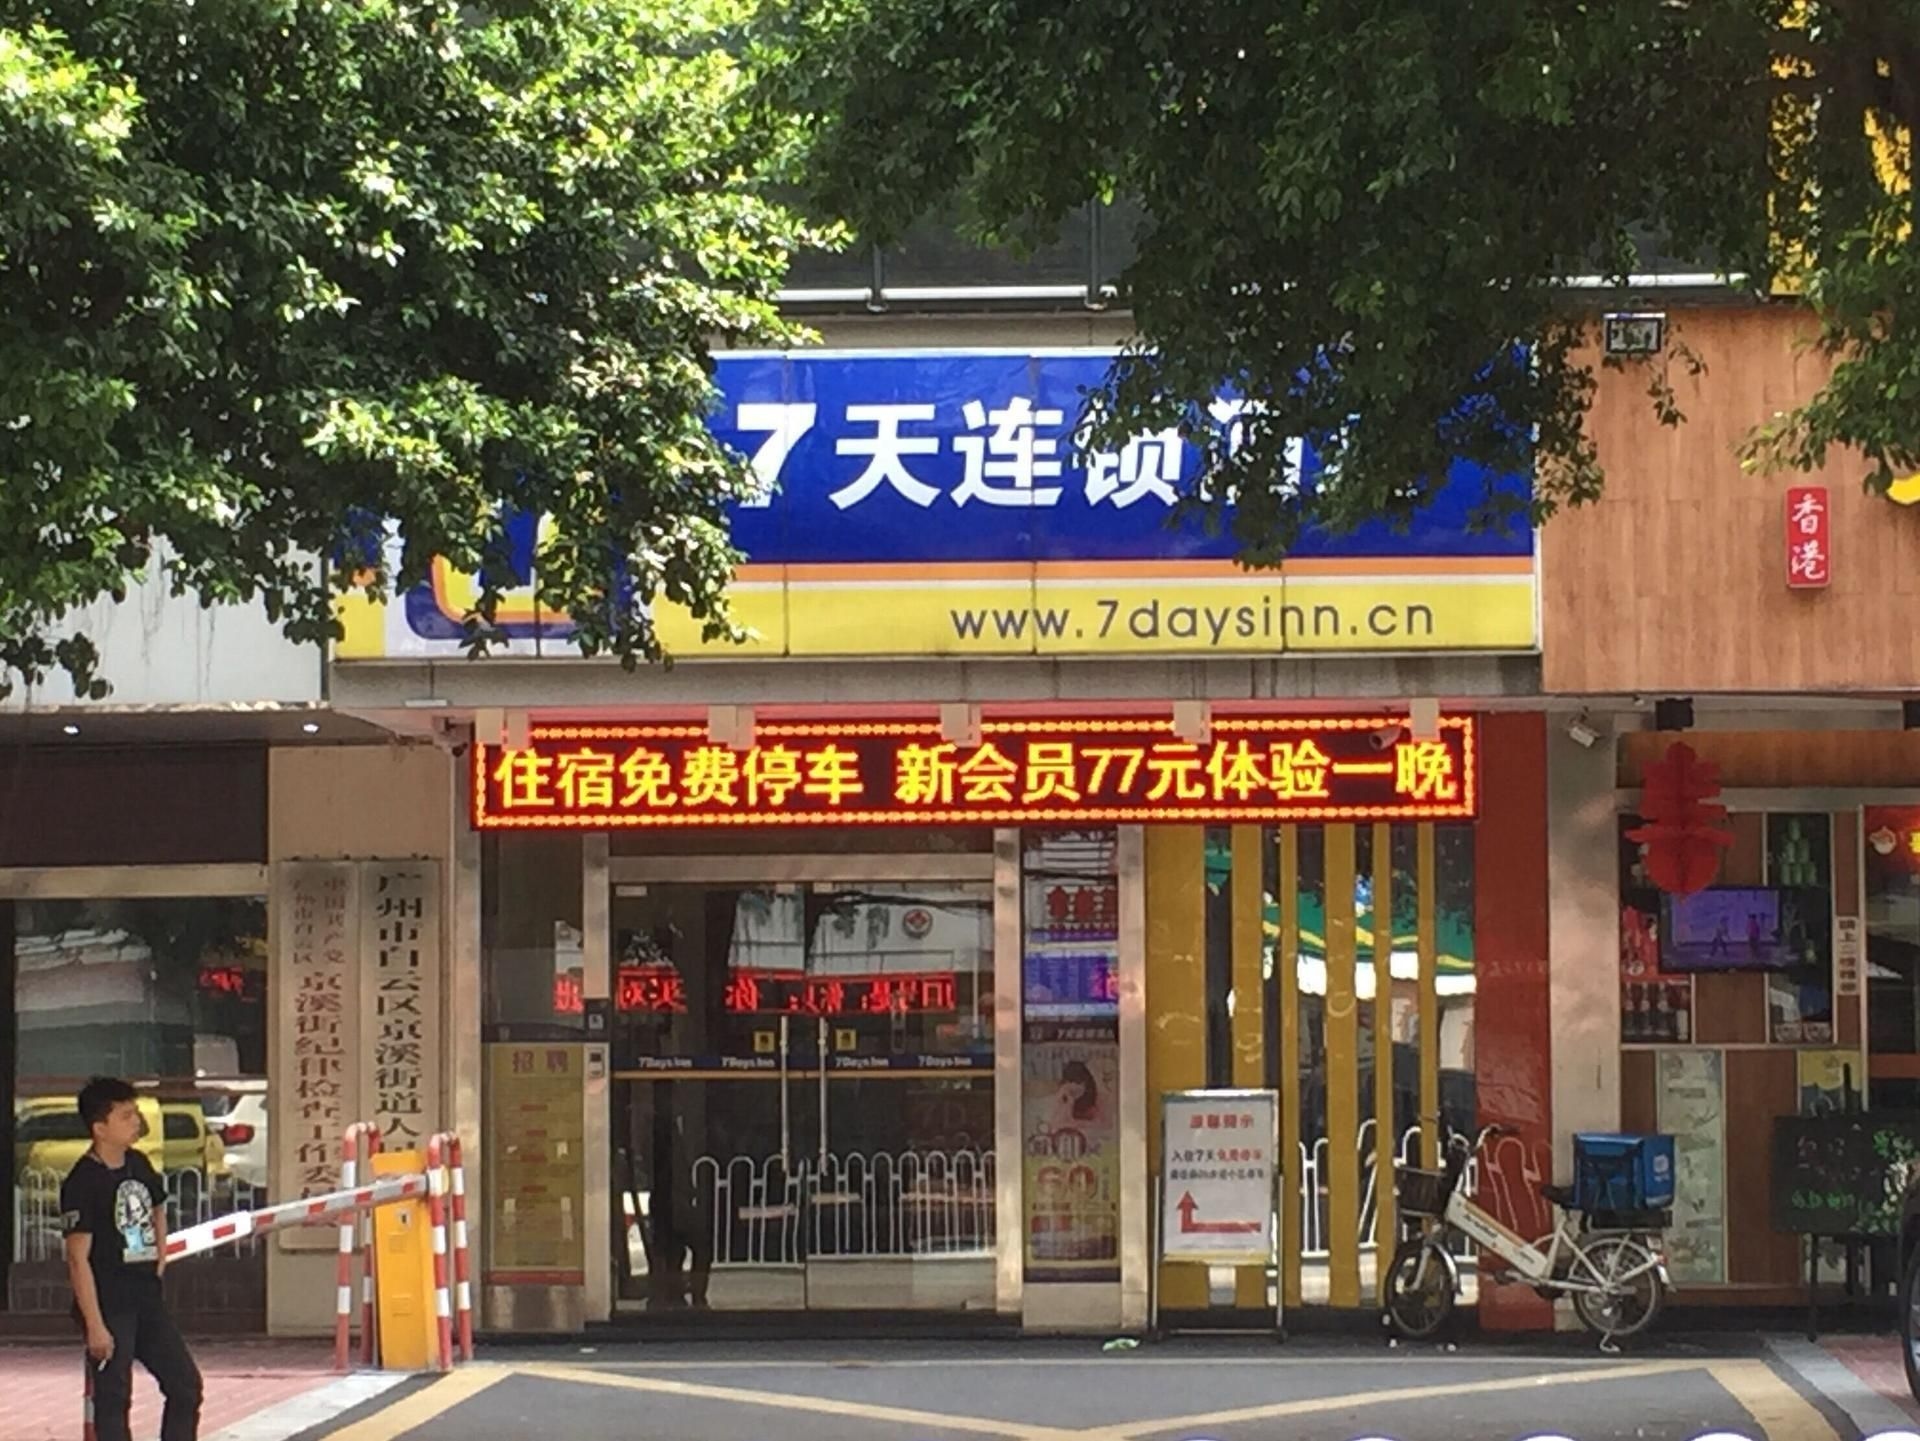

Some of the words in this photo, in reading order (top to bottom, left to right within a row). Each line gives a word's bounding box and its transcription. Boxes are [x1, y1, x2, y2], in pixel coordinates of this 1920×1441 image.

[731, 398, 1420, 512] 7天连锁
[1791, 492, 1826, 580] 香港
[953, 595, 1433, 647] www.7daysinn.cn
[495, 744, 865, 810] 住宿免费停车
[896, 741, 1456, 806] 新会员77元体验一晚
[375, 872, 423, 1153] 广州市白云区京溪街道人
